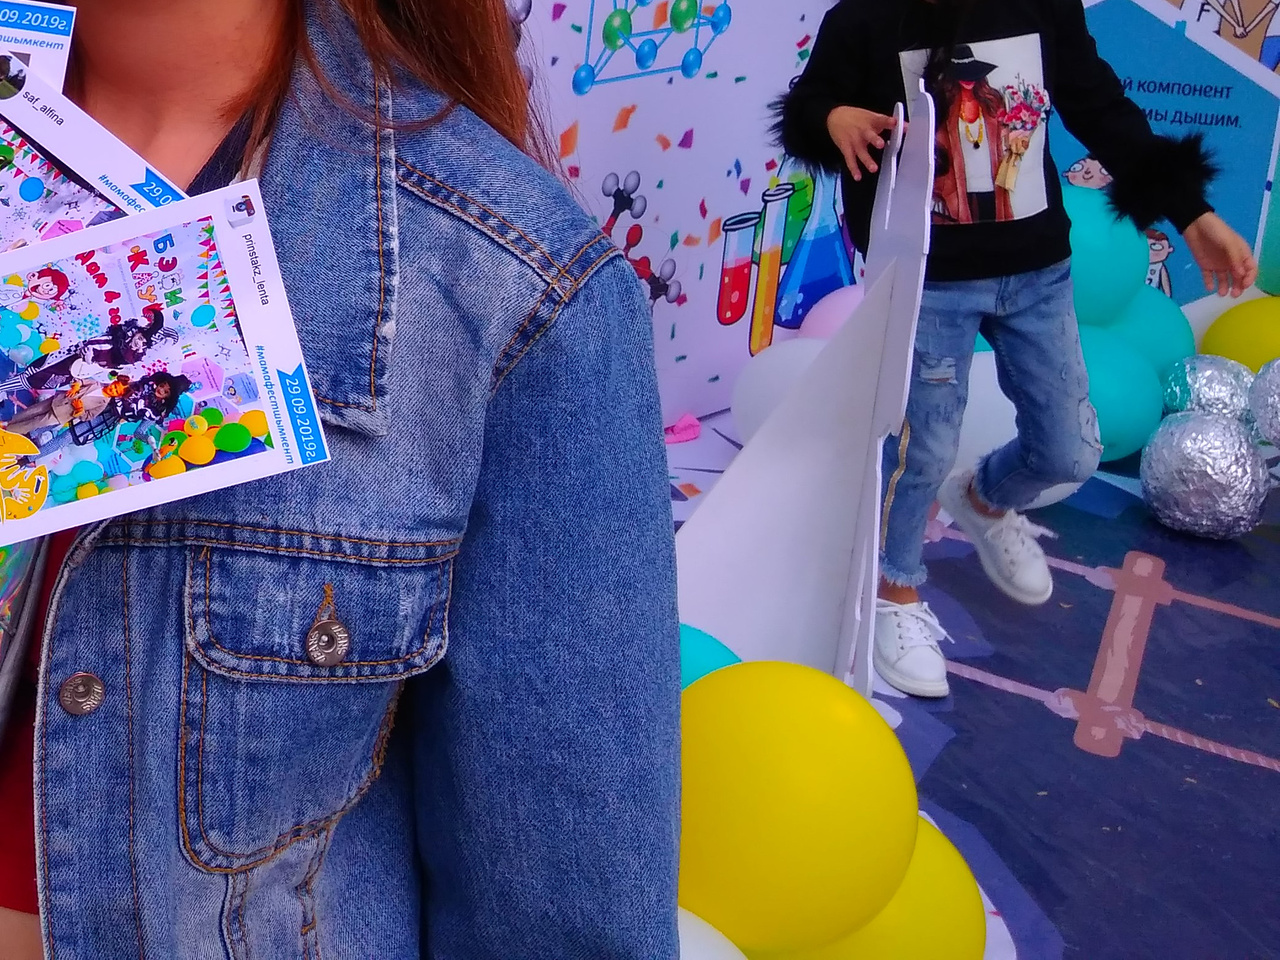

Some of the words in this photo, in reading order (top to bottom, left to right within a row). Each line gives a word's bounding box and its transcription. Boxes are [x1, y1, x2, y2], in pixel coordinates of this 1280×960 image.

[1196, 3, 1210, 22] F
[1137, 79, 1233, 99] компонент
[22, 90, 65, 126] saf_alfina
[1143, 109, 1168, 121] мы
[1170, 110, 1242, 128] дышим.
[98, 174, 146, 213] #мамафес
[242, 233, 269, 306] prinstakz_lenta
[255, 344, 294, 465] #мамафестшымкент
[285, 377, 317, 462] 29.09.2019г.
